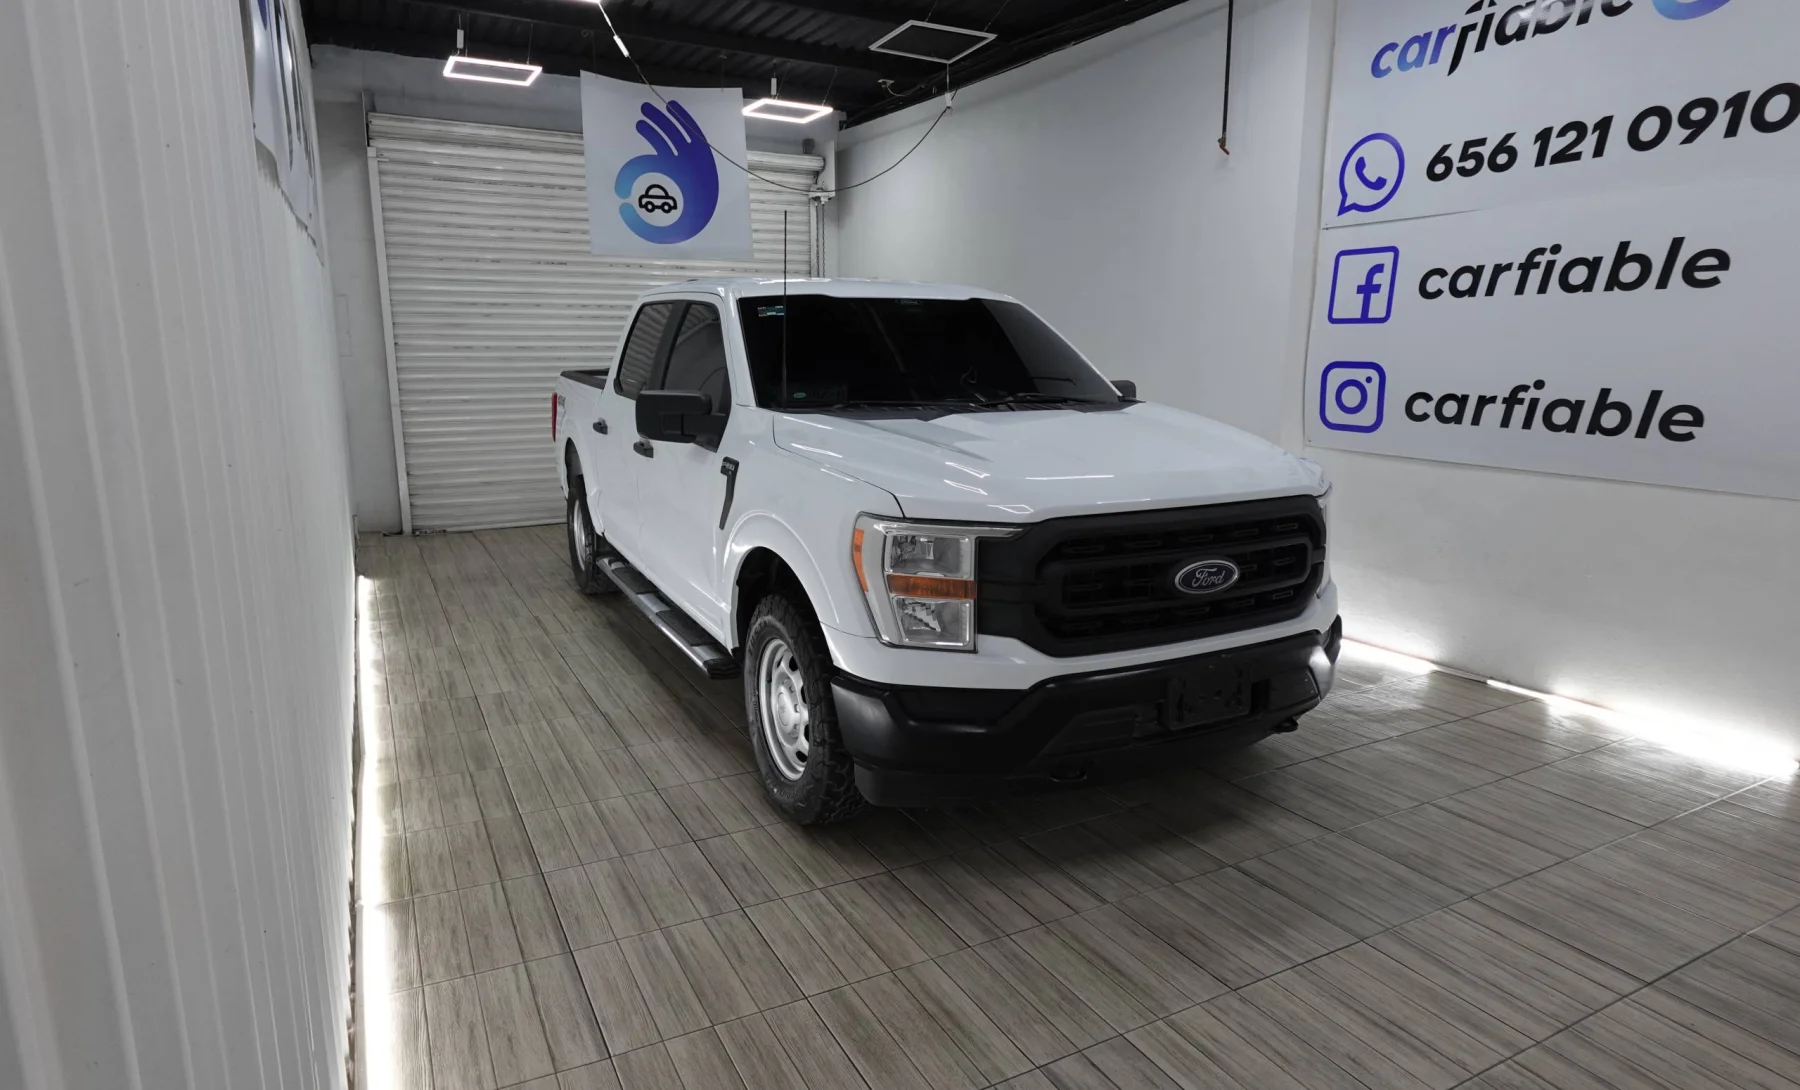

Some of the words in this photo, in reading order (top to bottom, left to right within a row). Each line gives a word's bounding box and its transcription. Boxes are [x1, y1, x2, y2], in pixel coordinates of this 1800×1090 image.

[1426, 132, 1518, 182] 656
[1534, 115, 1614, 167] 121
[1627, 83, 1800, 152] 0910
[1418, 237, 1731, 300] carfiable
[1404, 379, 1705, 442] carfiable
[1191, 567, 1226, 588] Ford
